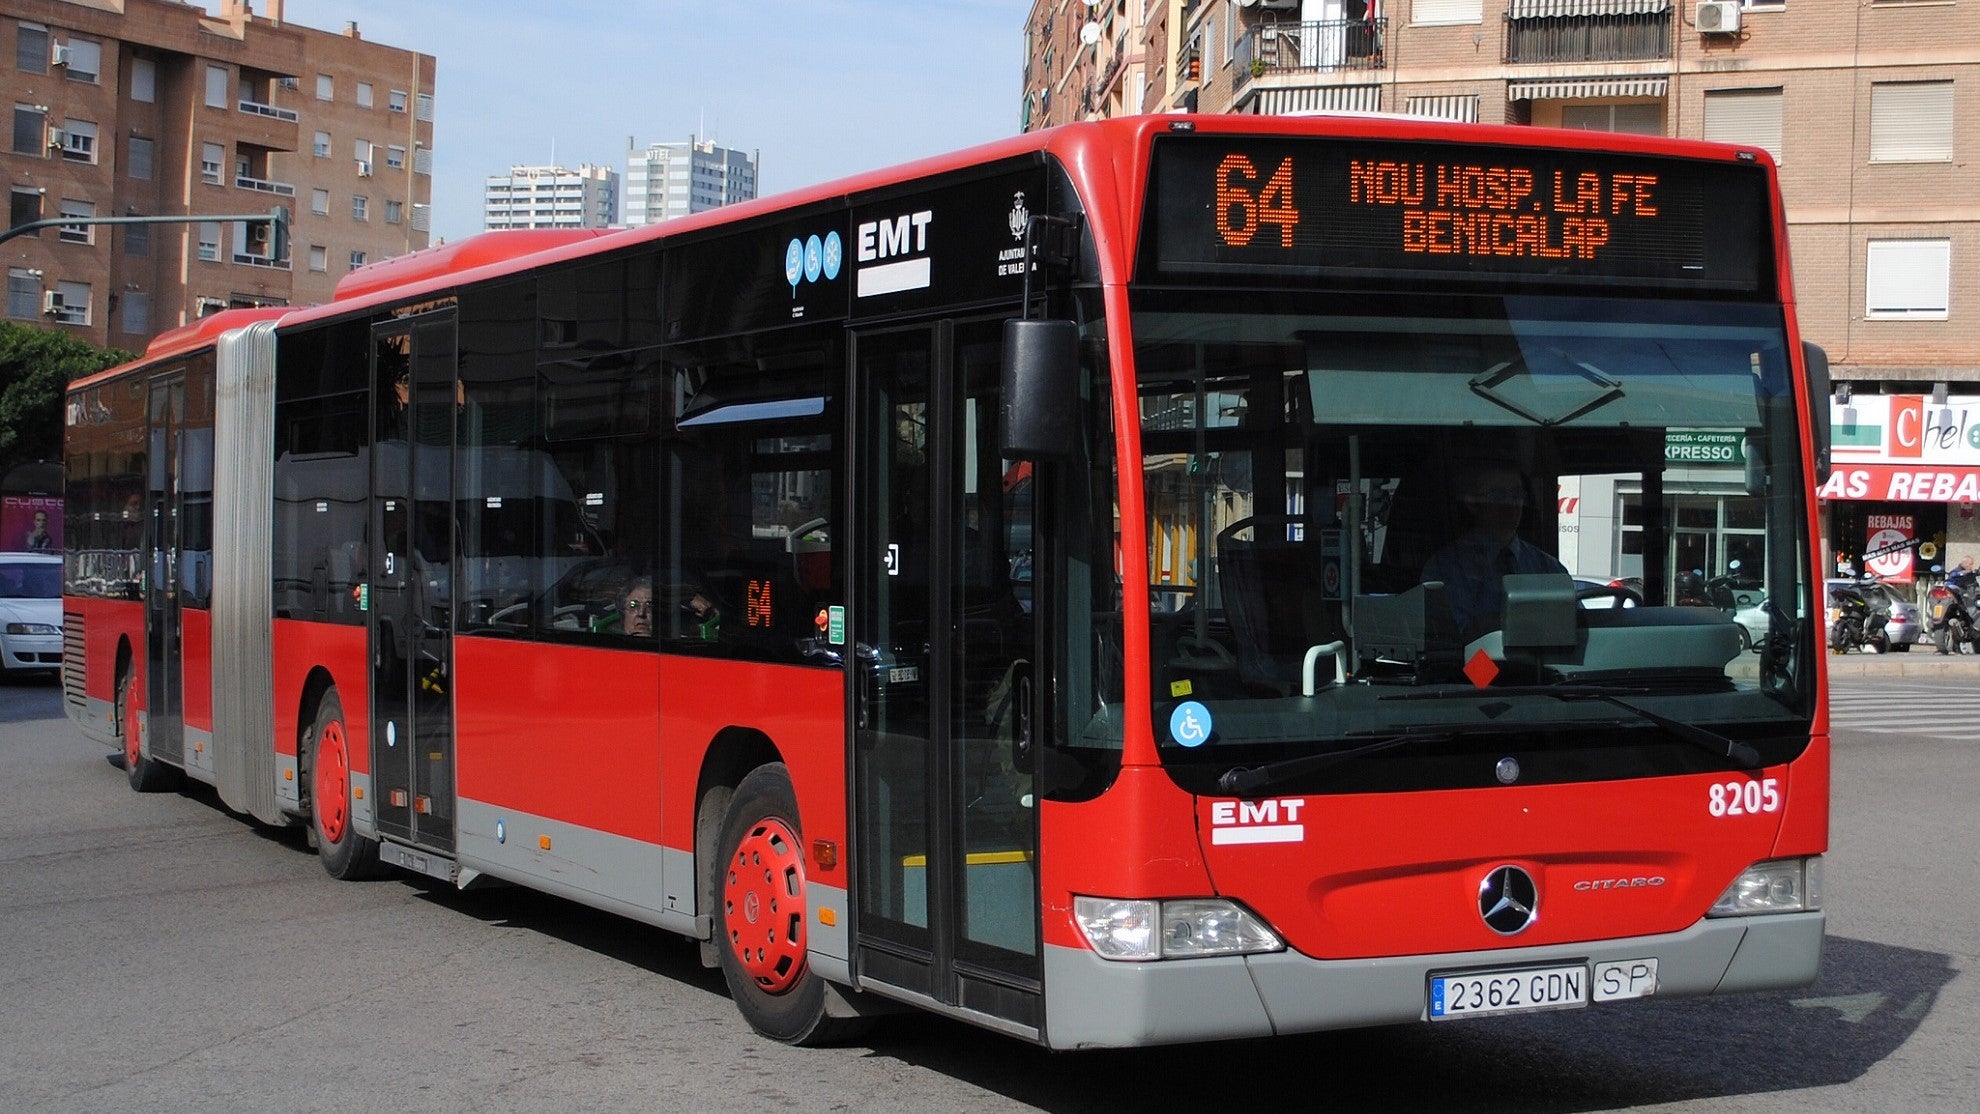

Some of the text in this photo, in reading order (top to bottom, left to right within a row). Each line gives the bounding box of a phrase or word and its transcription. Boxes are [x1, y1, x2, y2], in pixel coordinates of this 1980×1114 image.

[1215, 154, 1299, 248] 64
[1350, 160, 1658, 217] NOU HOSP. LA FE
[858, 210, 932, 262] EMT
[1403, 210, 1609, 260] BENICALAP
[998, 265, 1006, 276] DE
[1697, 435, 1736, 443] CAFETERÍA
[1816, 470, 1980, 500] AS REBA
[1868, 516, 1913, 529] REBAJAS
[748, 580, 771, 627] 64
[1212, 798, 1304, 826] EMT
[1708, 779, 1779, 818] 8205
[1573, 876, 1666, 891] CITARO
[1450, 978, 1520, 1011] 2362
[1530, 971, 1580, 1004] GDN
